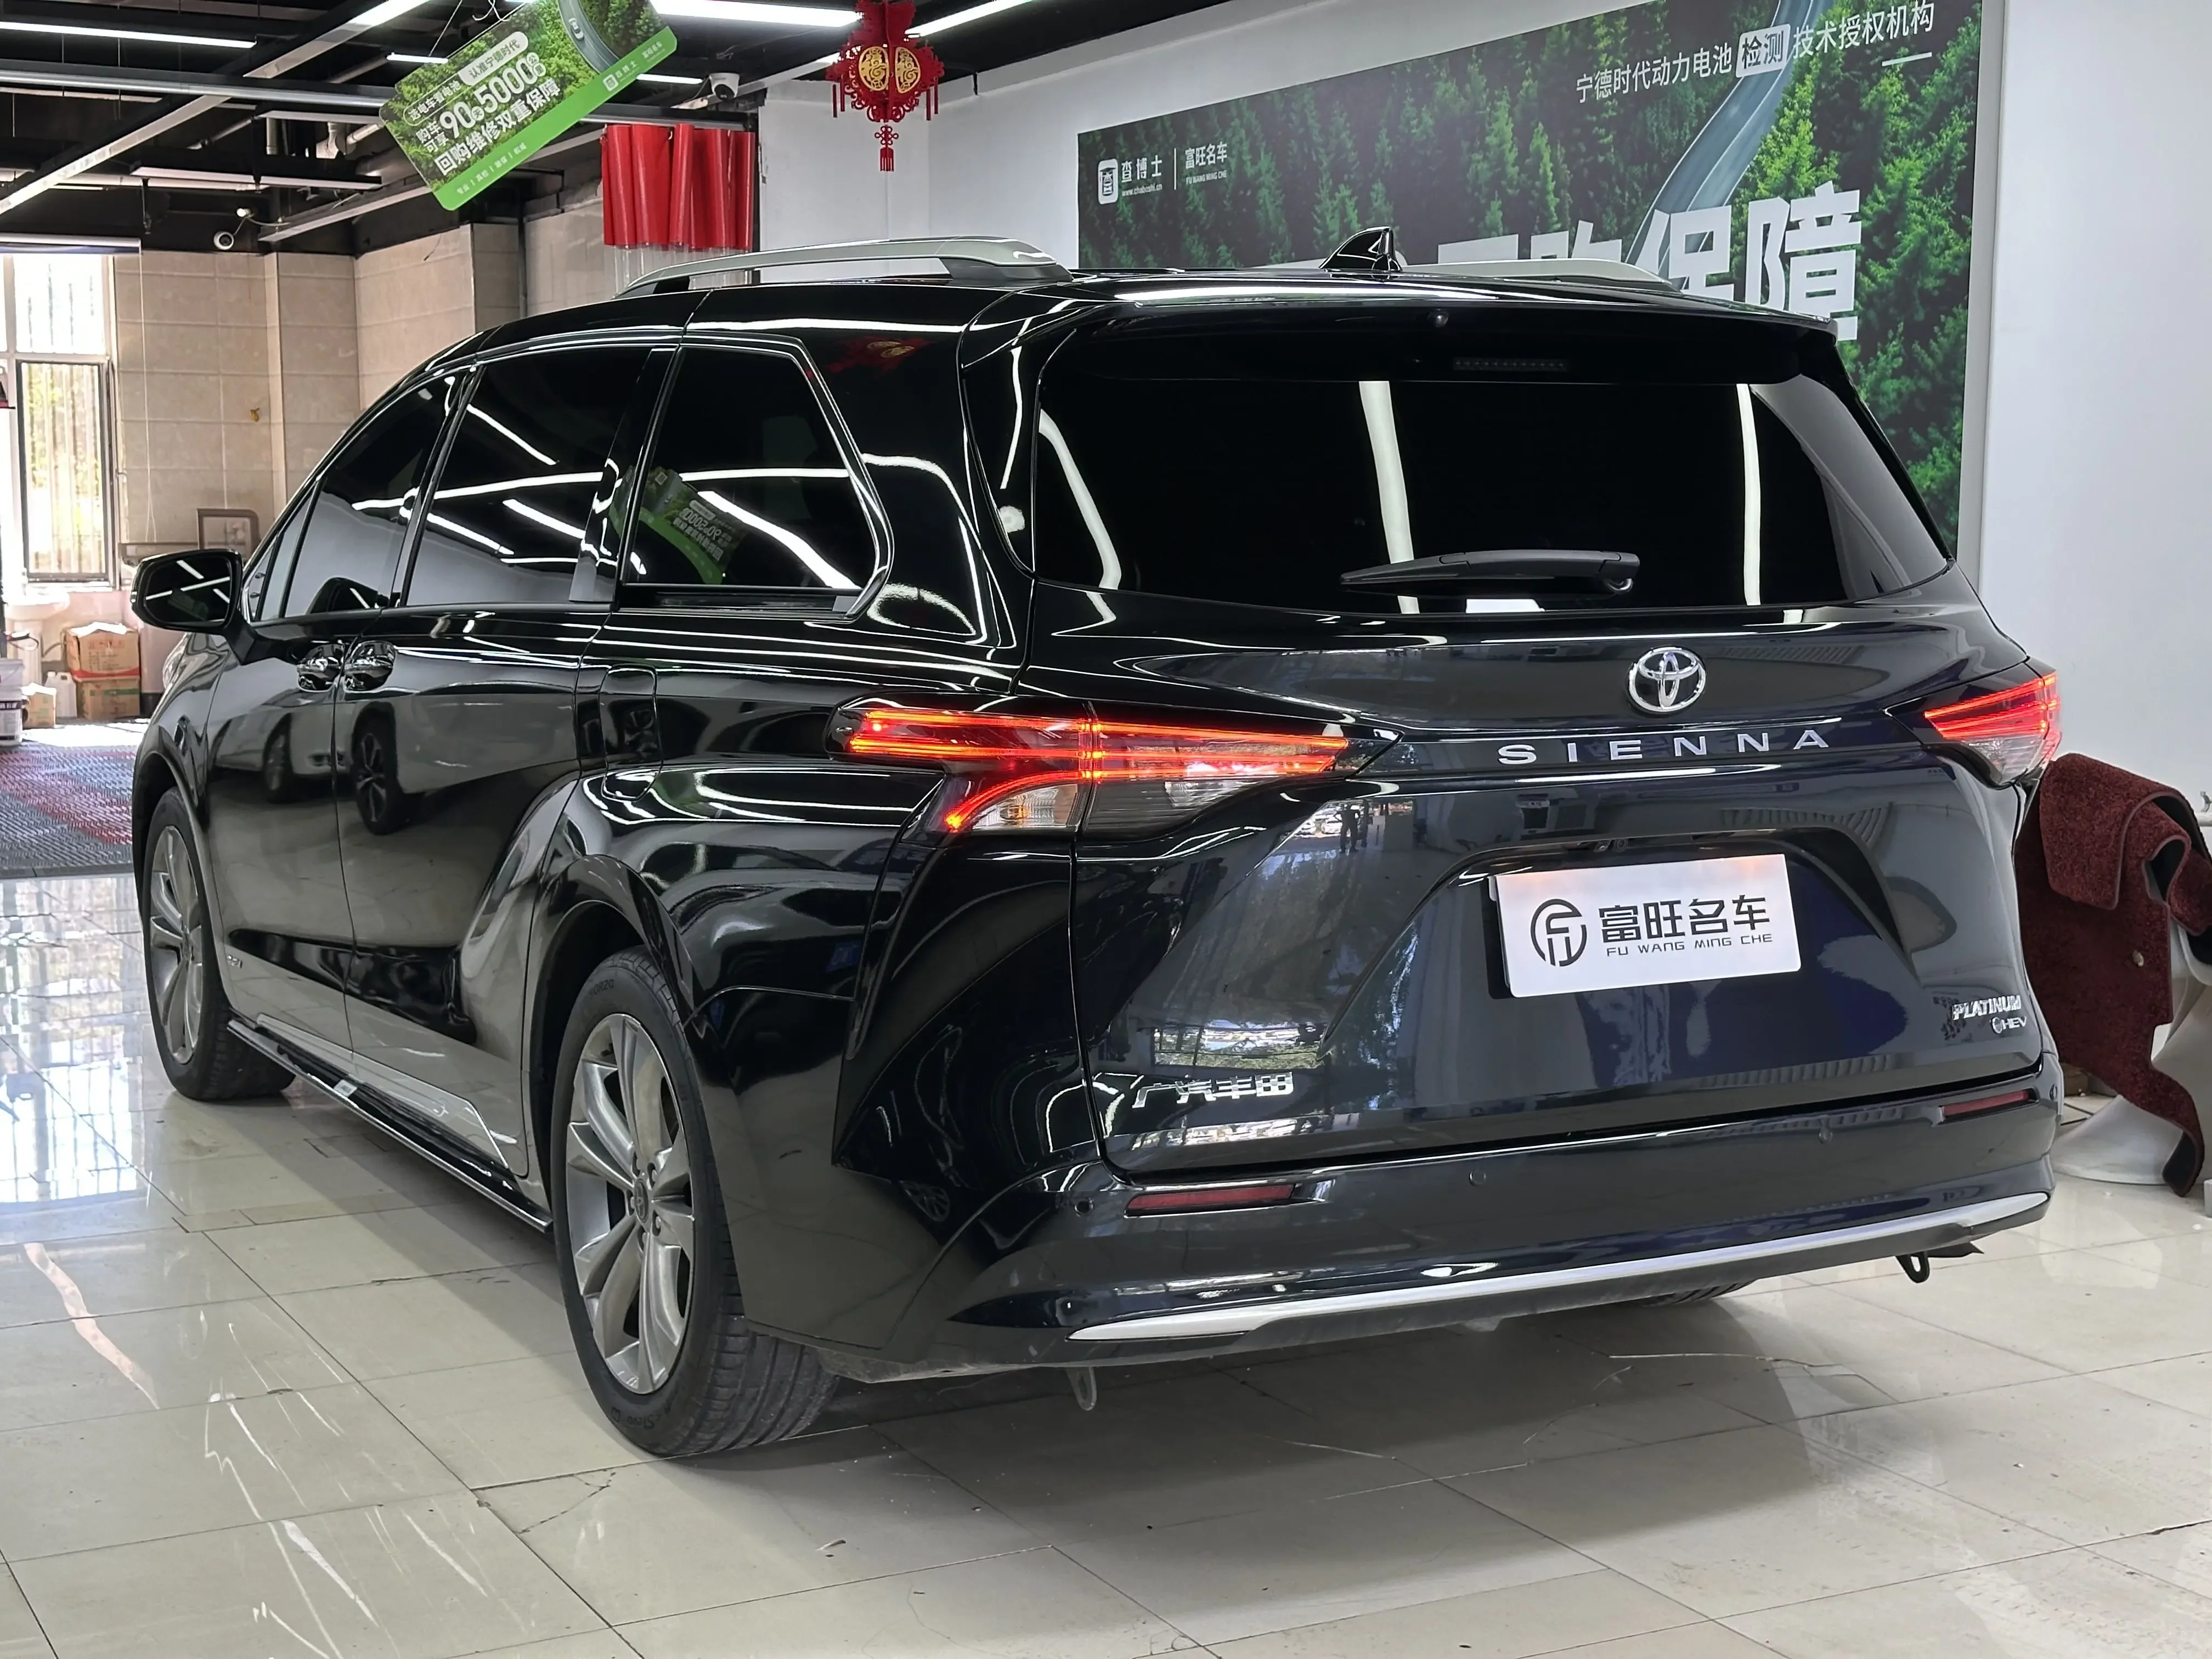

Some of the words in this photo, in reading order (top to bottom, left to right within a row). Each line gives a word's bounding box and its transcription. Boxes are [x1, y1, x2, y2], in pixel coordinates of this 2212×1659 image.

[469, 38, 521, 78] 认准宁德时代
[433, 78, 562, 176] 回购维修双重保障
[1185, 141, 1228, 170] 富旺名车
[1497, 729, 1829, 765] SIENNA
[1598, 894, 1770, 943] 富旺名车
[1606, 946, 1629, 956] FU
[1638, 941, 1685, 953] WANG
[1694, 936, 1732, 949] MING
[1740, 933, 1773, 945] CHE
[1953, 995, 2022, 1021] PLATINUM
[1132, 1071, 1294, 1109] 广汽丰田
